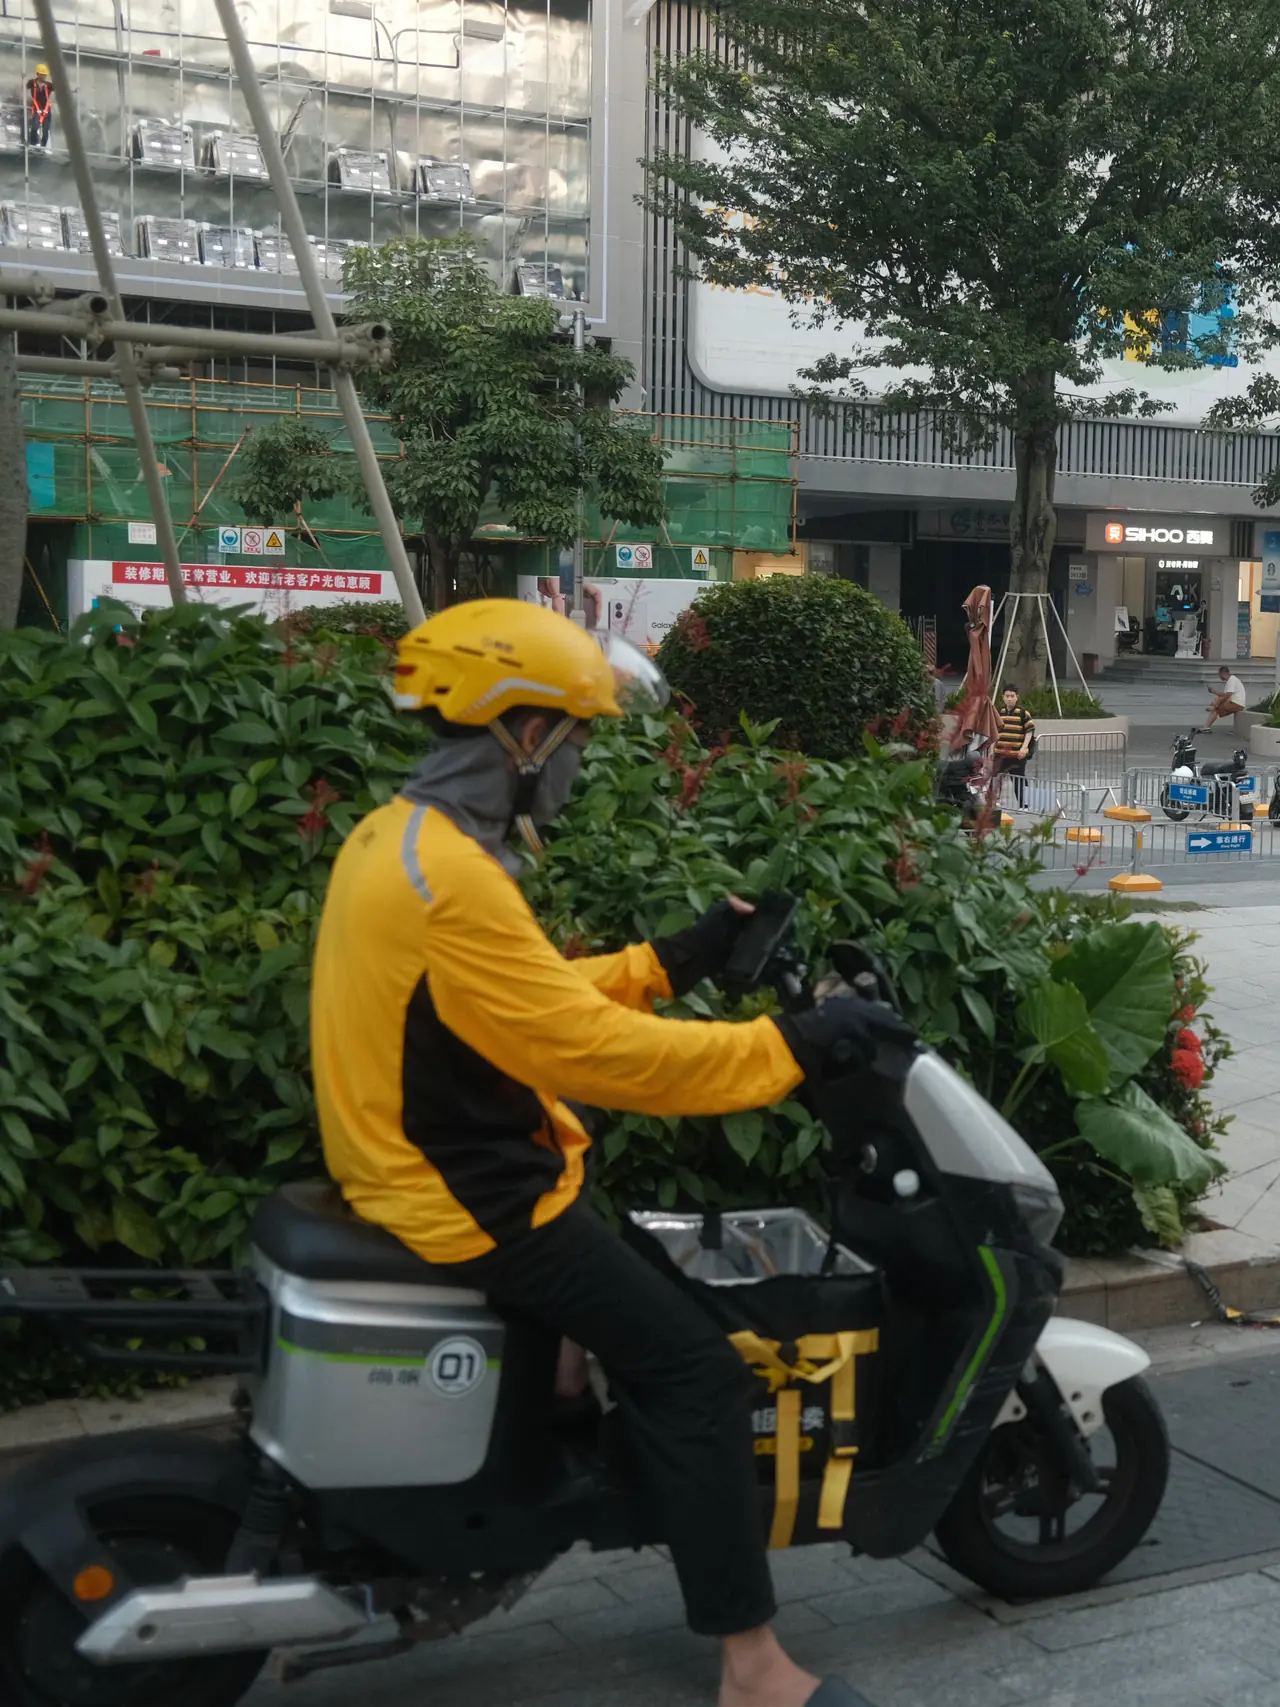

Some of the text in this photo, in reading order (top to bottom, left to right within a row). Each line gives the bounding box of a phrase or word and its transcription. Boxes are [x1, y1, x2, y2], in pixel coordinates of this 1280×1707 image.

[1125, 527, 1184, 543] SIHOO
[651, 622, 675, 630] Galax
[439, 1352, 476, 1381] 01
